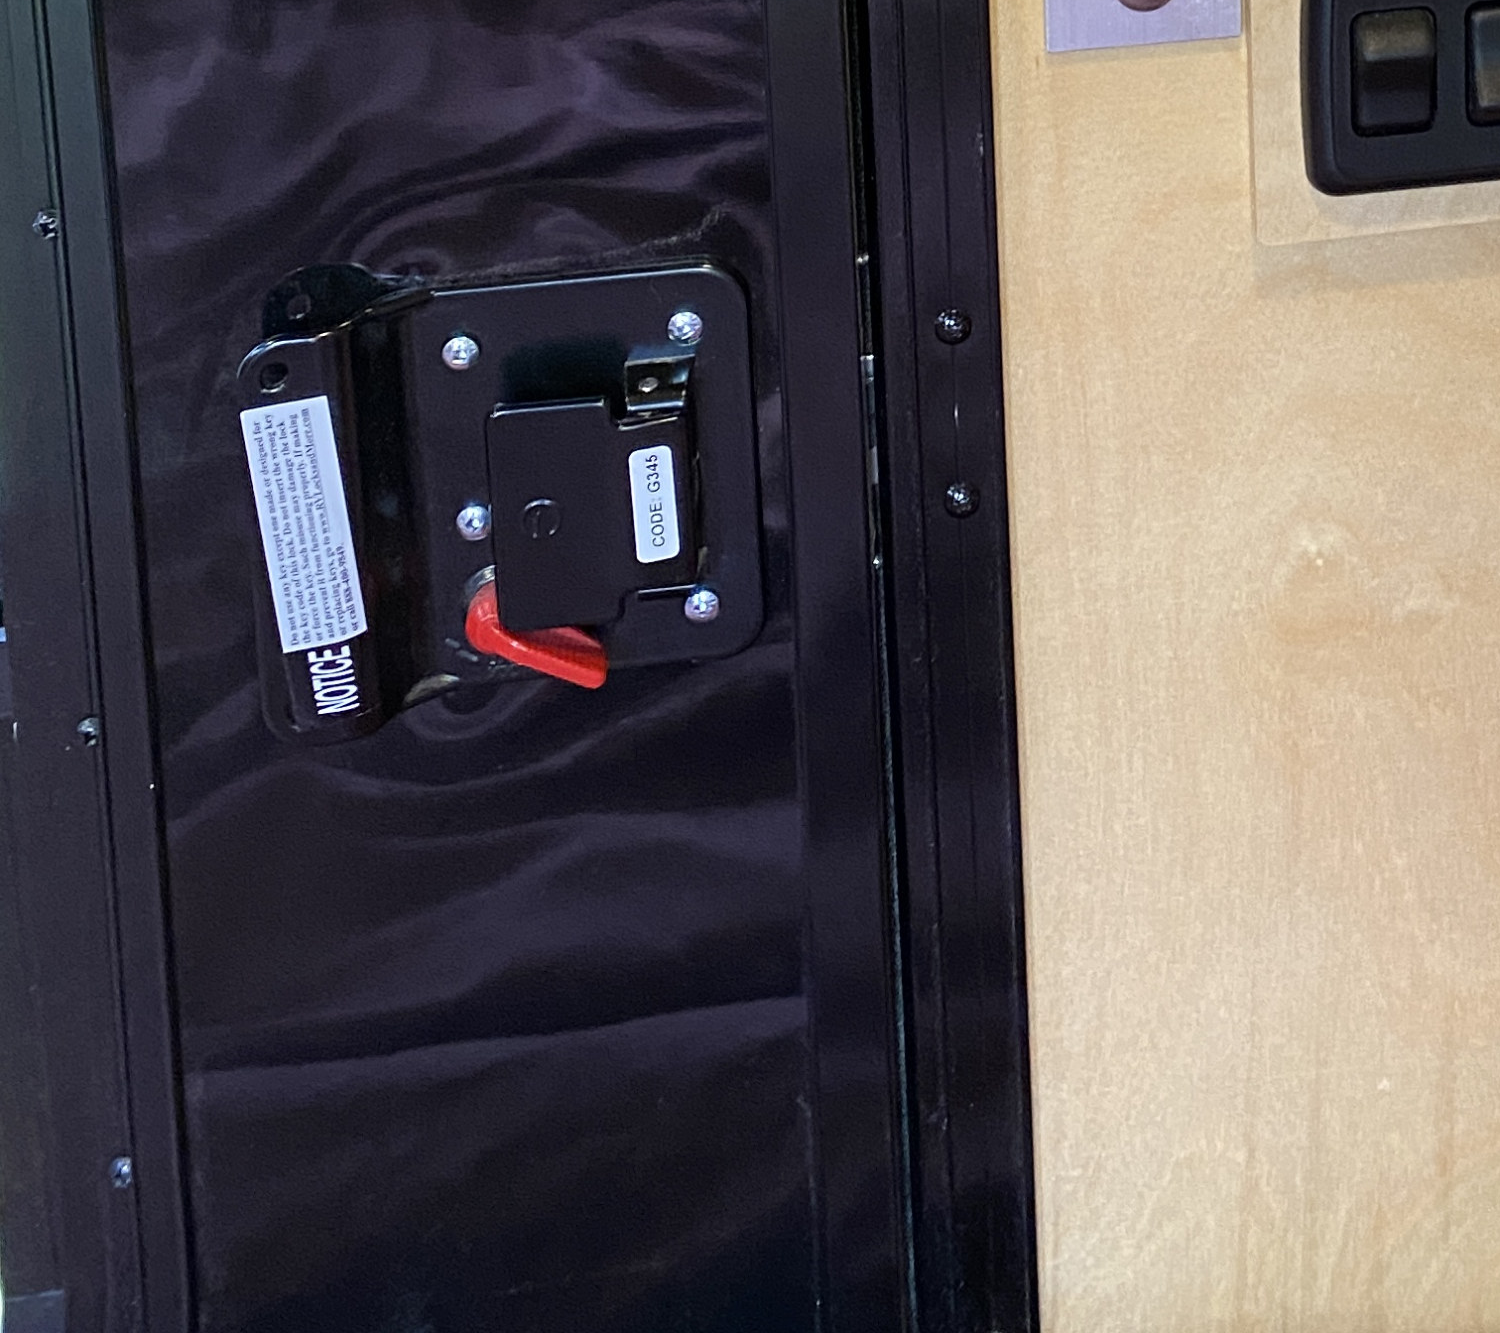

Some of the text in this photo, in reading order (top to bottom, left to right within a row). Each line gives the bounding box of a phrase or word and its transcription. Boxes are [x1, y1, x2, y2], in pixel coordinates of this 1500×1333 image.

[262, 413, 276, 430] key
[275, 420, 288, 440] lock
[286, 413, 303, 448] making
[267, 430, 280, 460] wrong
[279, 441, 290, 456] the
[292, 448, 303, 458] If
[270, 461, 282, 476] the
[282, 457, 298, 493] damage
[273, 477, 287, 503] insert
[290, 493, 302, 513] may
[645, 454, 665, 547] CODE: G345
[279, 504, 289, 520] not
[251, 419, 299, 646] Do not use any key except one made or designed for
[281, 521, 292, 535] Do
[302, 501, 321, 552] functioning
[321, 535, 331, 545] to
[298, 546, 310, 570] Such
[324, 545, 335, 558] go
[287, 559, 300, 577] this
[311, 553, 324, 576] from
[290, 577, 302, 588] of
[292, 589, 306, 610] code
[306, 590, 317, 605] the
[317, 585, 334, 620] prevent
[328, 582, 347, 624] replacing
[296, 612, 310, 628] key
[308, 607, 321, 630] force
[300, 629, 312, 644] the
[315, 631, 323, 641] or
[323, 621, 335, 639] and
[338, 625, 347, 636] or
[307, 645, 361, 715] NOTICE
